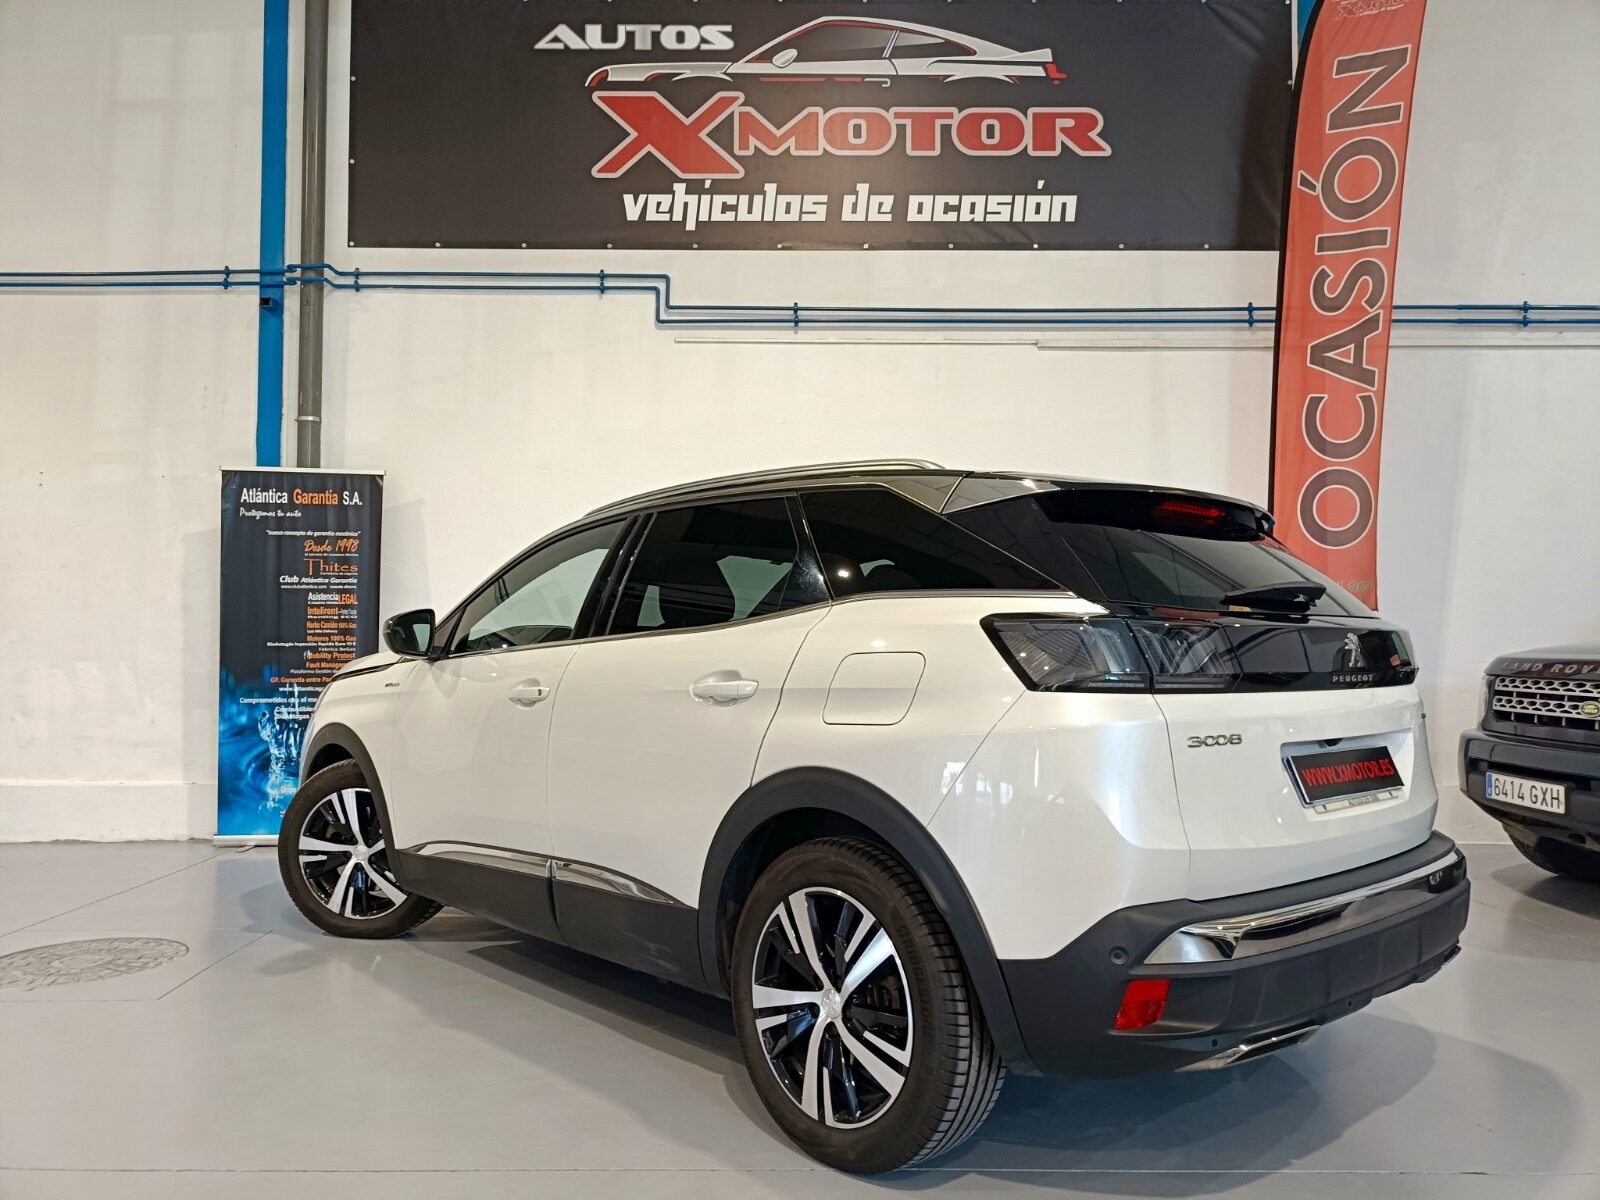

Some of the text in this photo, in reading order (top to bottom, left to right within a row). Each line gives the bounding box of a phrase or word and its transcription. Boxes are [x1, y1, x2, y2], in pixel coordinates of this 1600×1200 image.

[533, 24, 734, 52] AUTOS
[591, 90, 1112, 179] XMOTOR
[622, 180, 1077, 232] vehículos de ocasión
[1296, 44, 1412, 550] OCASIÓN
[240, 488, 362, 505] Atlántica Garantía S.A.
[304, 539, 359, 552] Desde 1998
[304, 559, 358, 575] Thites
[1502, 662, 1542, 672] LAND
[1186, 734, 1243, 748] 3008
[1302, 758, 1394, 786] WWW.XMOTOR.ES
[1494, 778, 1561, 809] 6414 GXH
